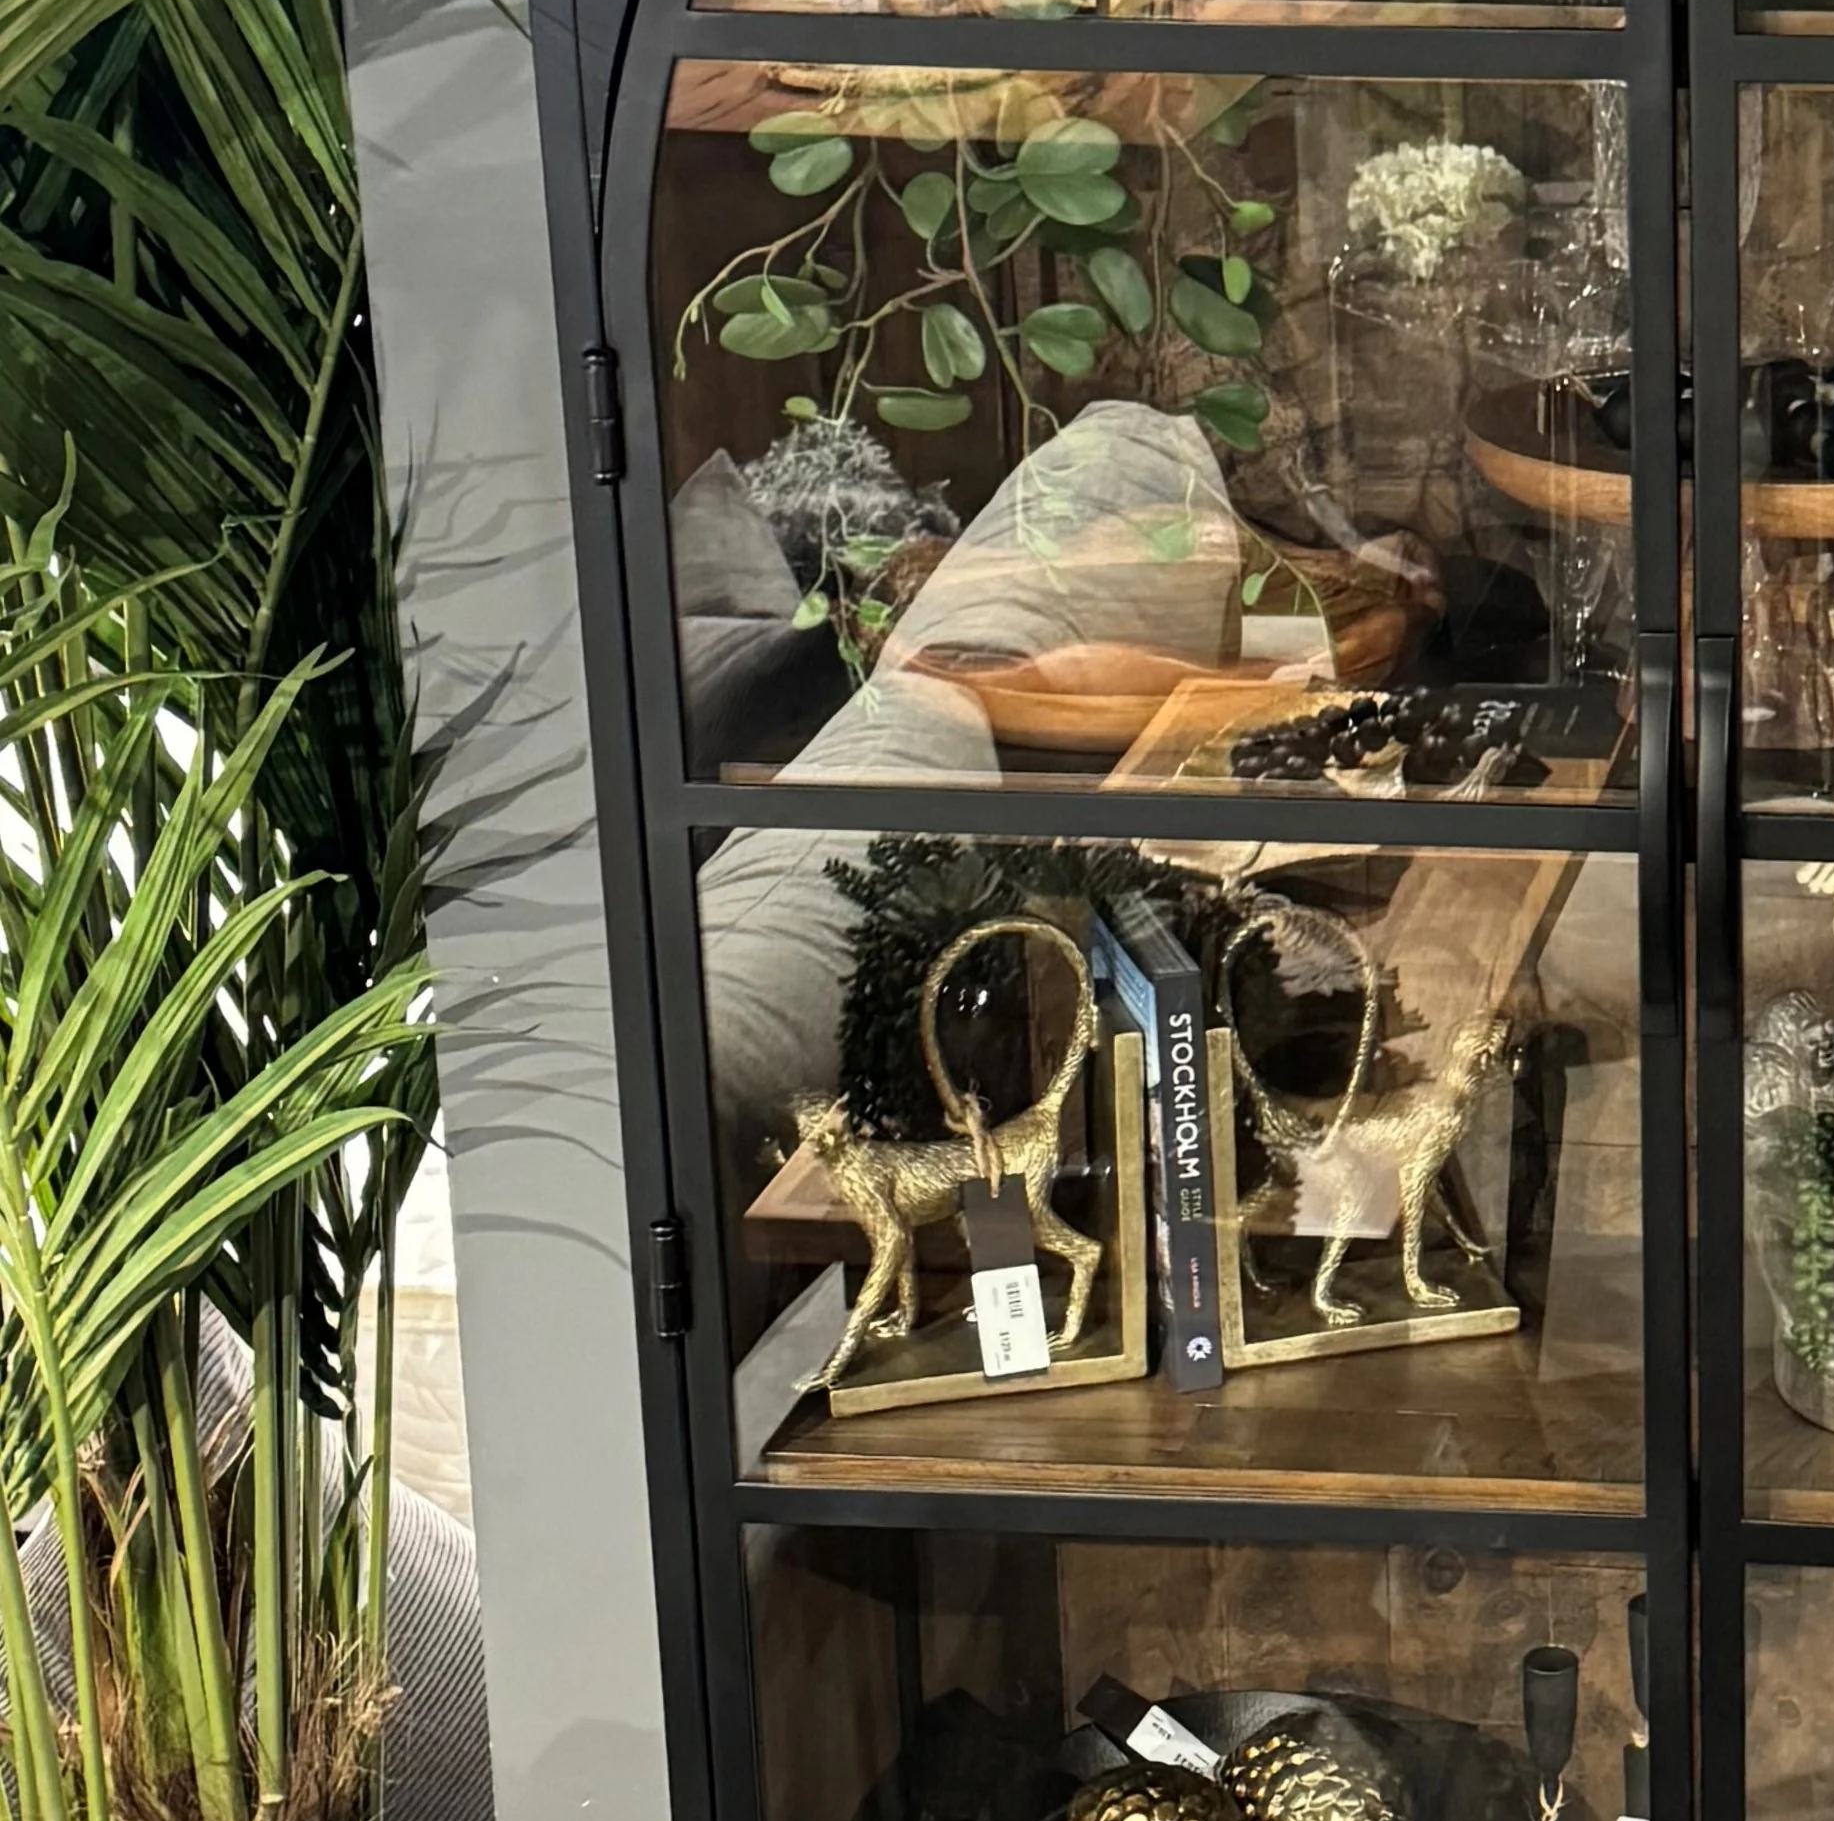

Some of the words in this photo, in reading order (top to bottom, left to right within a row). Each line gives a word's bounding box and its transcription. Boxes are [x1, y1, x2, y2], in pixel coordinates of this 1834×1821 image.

[1168, 1012, 1201, 1179] STOCKHOLM
[1179, 1188, 1191, 1222] GUIDE
[1191, 1187, 1202, 1219] STYLE
